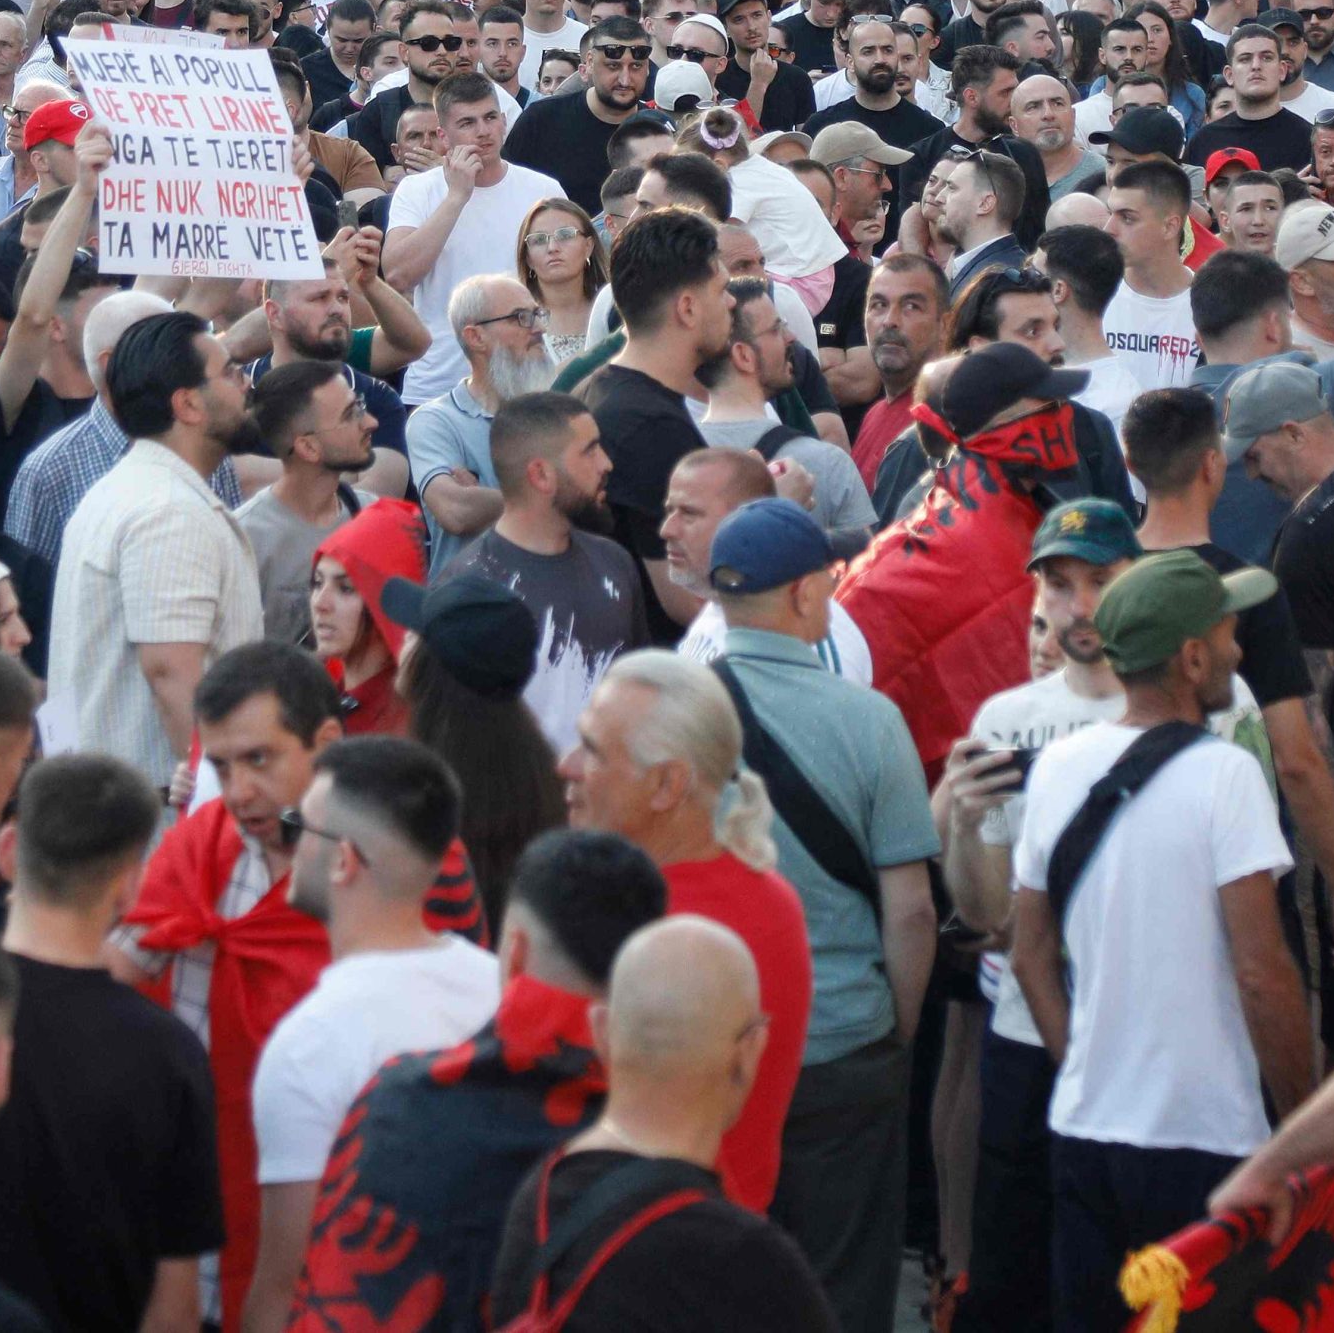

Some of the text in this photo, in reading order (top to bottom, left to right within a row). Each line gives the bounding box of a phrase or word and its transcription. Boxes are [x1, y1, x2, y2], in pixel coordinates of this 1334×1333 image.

[70, 49, 272, 93] MJERË AI POPULL
[128, 90, 196, 131] PRET
[199, 96, 288, 135] LIRINË
[113, 132, 288, 173] NGA TË TJERËT
[103, 178, 305, 222] DHE NUK NGRIHET
[103, 220, 310, 262] TA MARRË VETË
[217, 262, 253, 276] FISHTA
[1106, 331, 1200, 359] DSQUARED2
